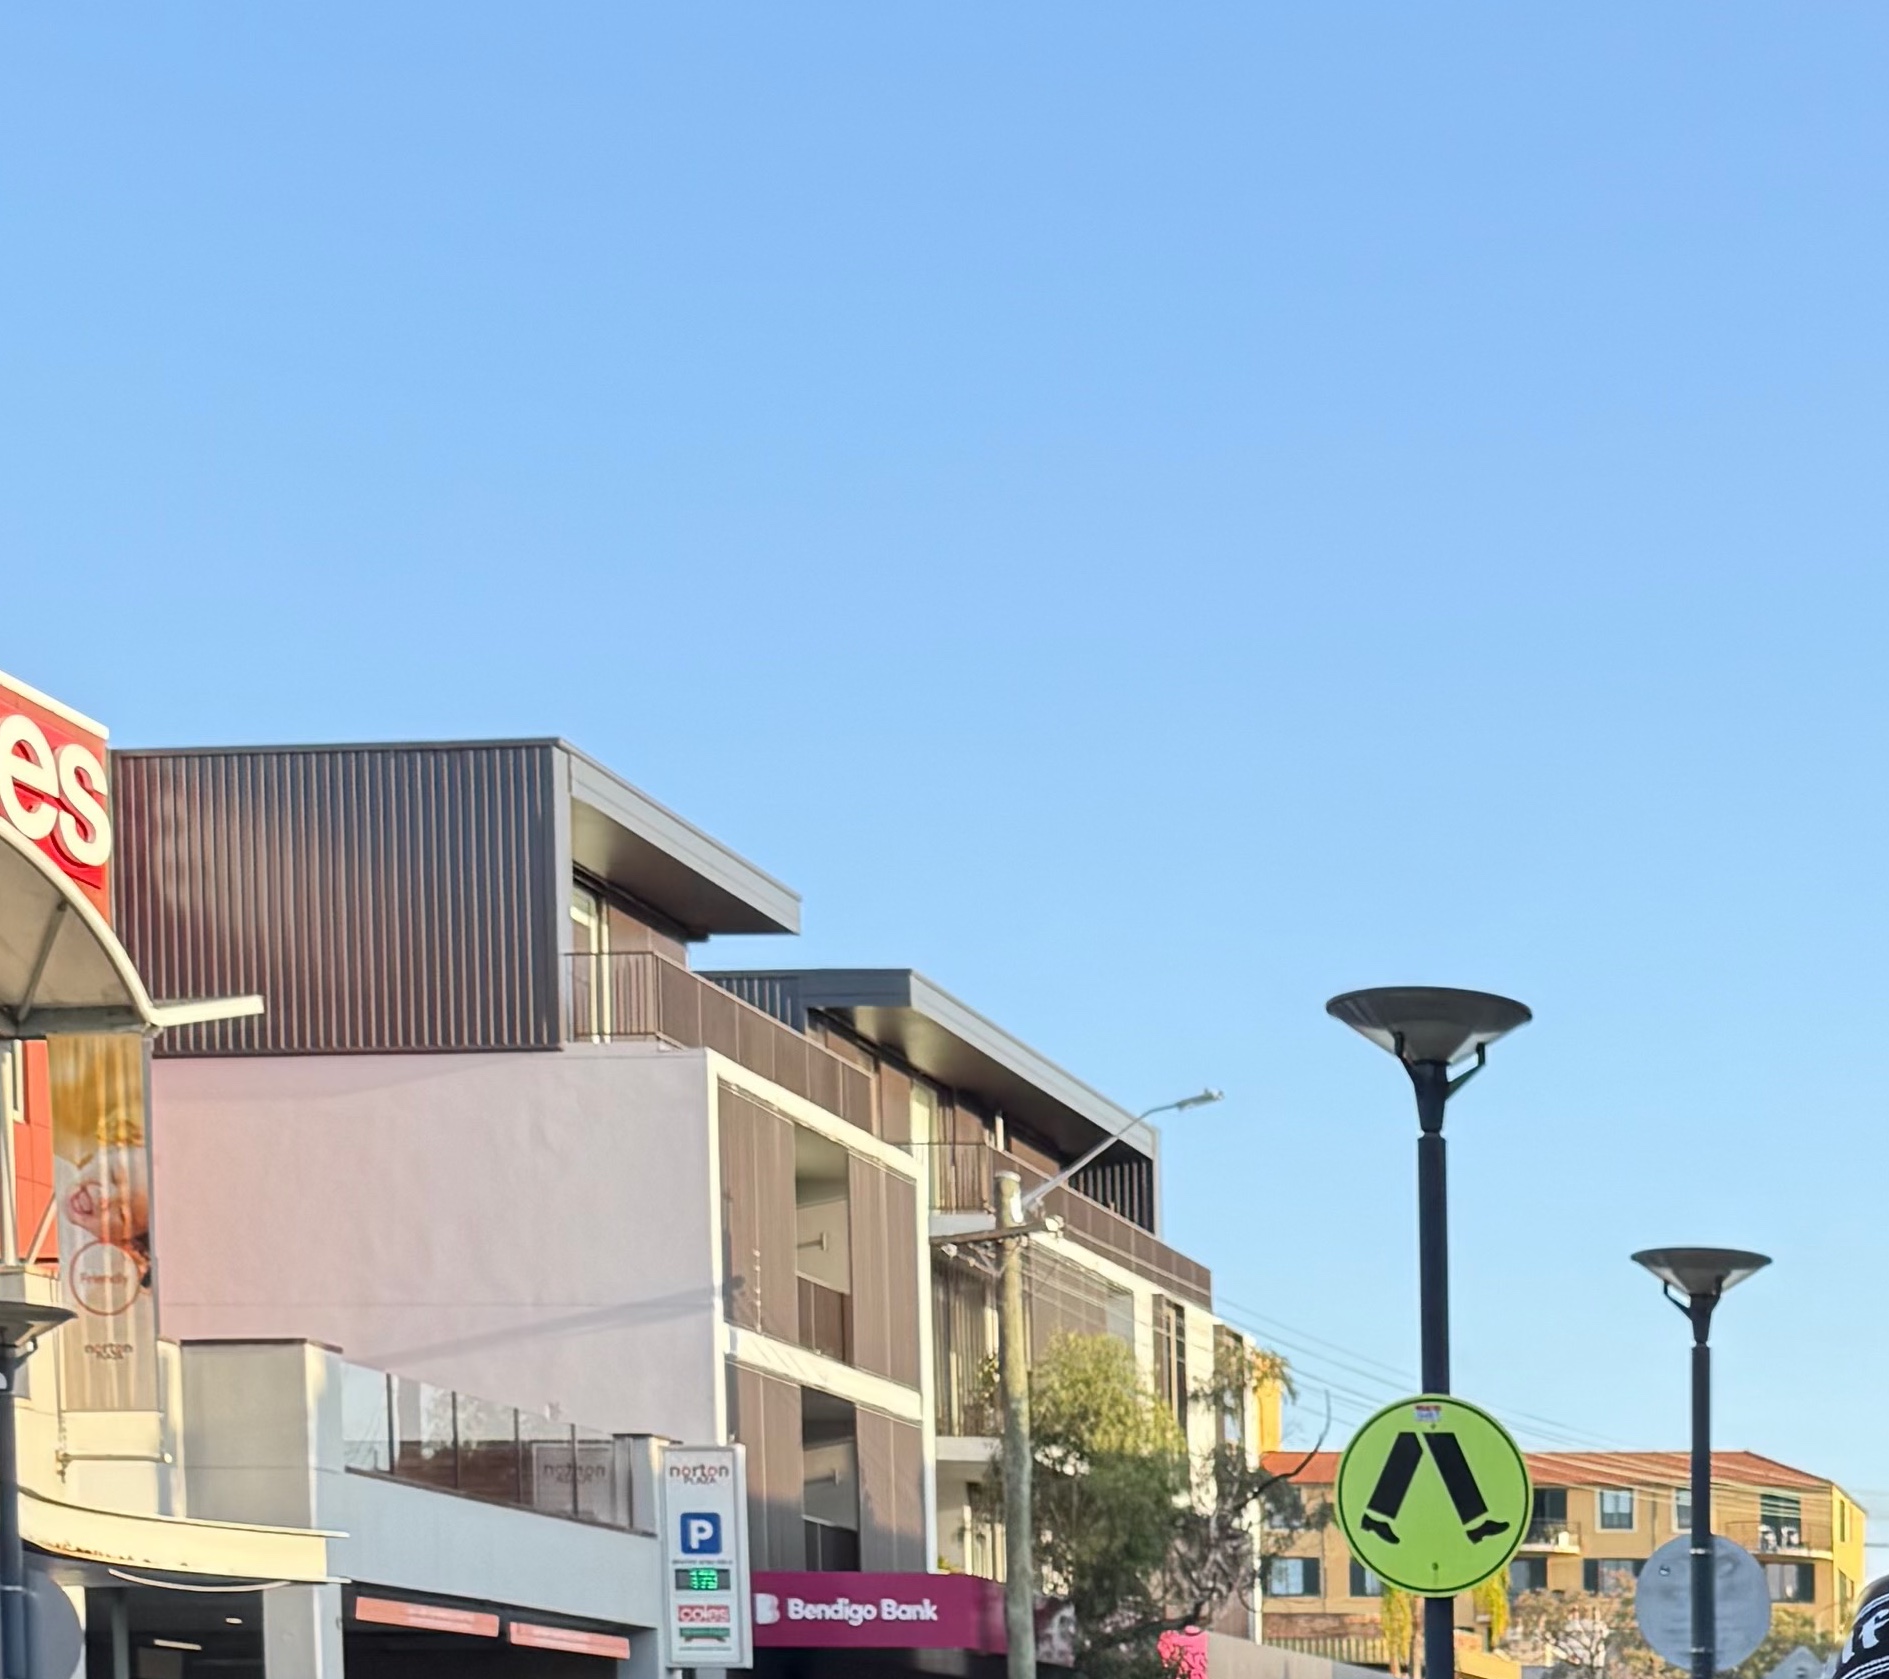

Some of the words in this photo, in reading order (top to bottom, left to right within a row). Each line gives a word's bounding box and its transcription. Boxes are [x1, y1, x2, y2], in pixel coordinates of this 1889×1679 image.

[0, 714, 111, 866] es
[669, 1464, 730, 1478] norton
[690, 1519, 714, 1550] P
[787, 1598, 878, 1627] Bendigo
[881, 1599, 938, 1621] Bank
